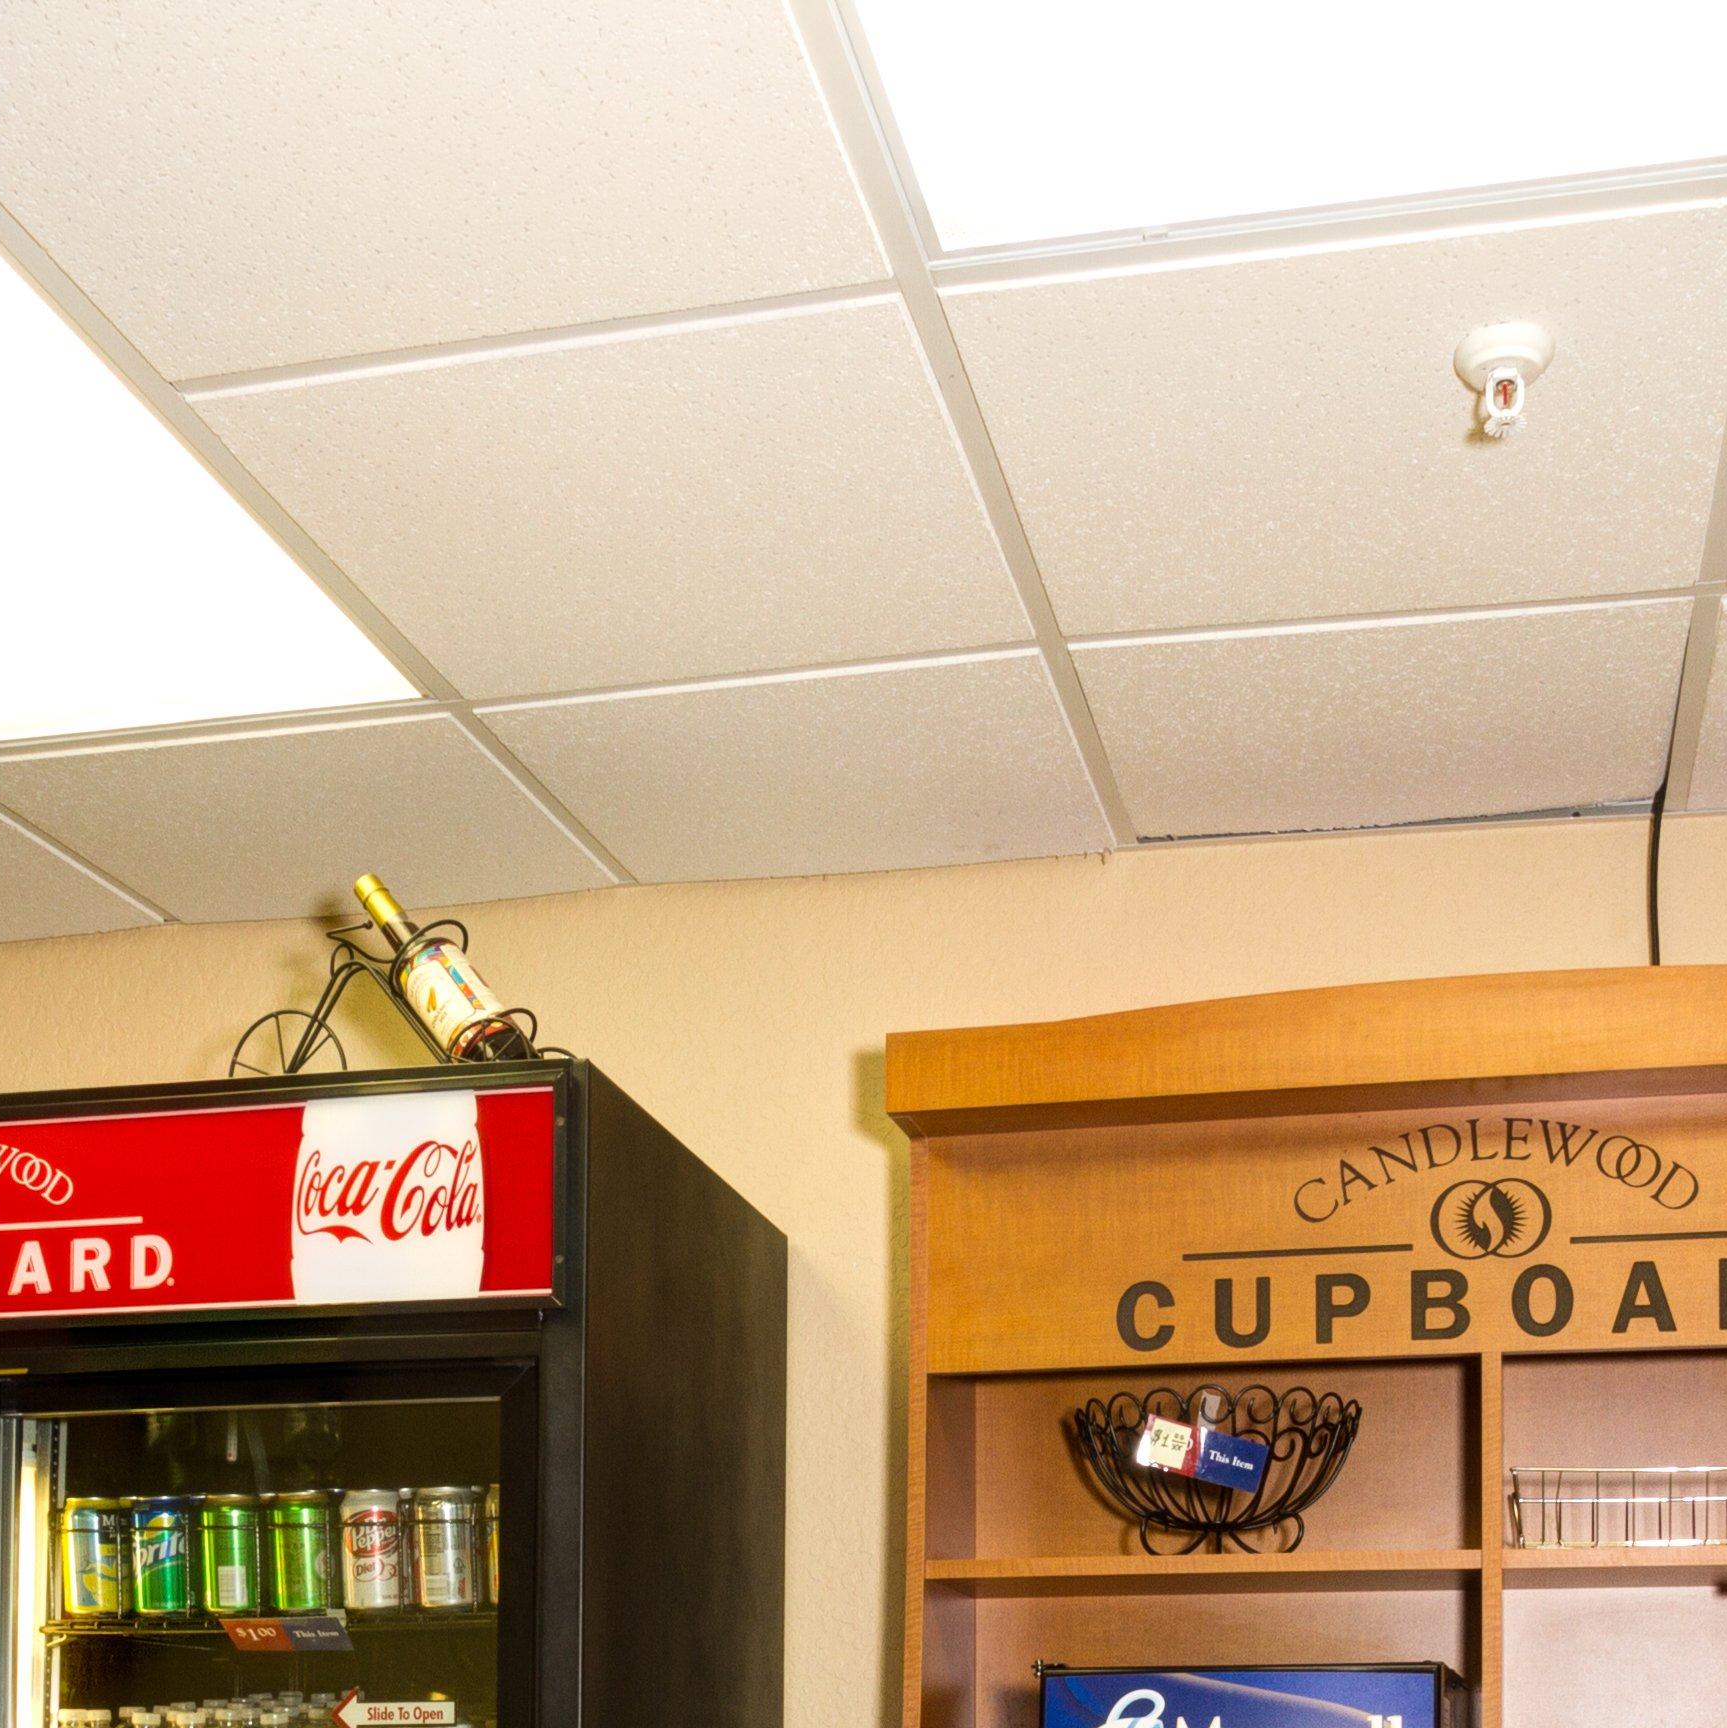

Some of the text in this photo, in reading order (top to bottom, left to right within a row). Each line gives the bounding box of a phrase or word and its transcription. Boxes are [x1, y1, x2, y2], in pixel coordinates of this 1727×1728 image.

[1293, 1116, 1700, 1223] CANDLEWOOD
[295, 1138, 484, 1245] Coca-Cola
[1209, 1449, 1254, 1471] This Item
[293, 1628, 317, 1641] This
[318, 1629, 340, 1641] Item
[367, 1706, 444, 1724] Slide To Open
